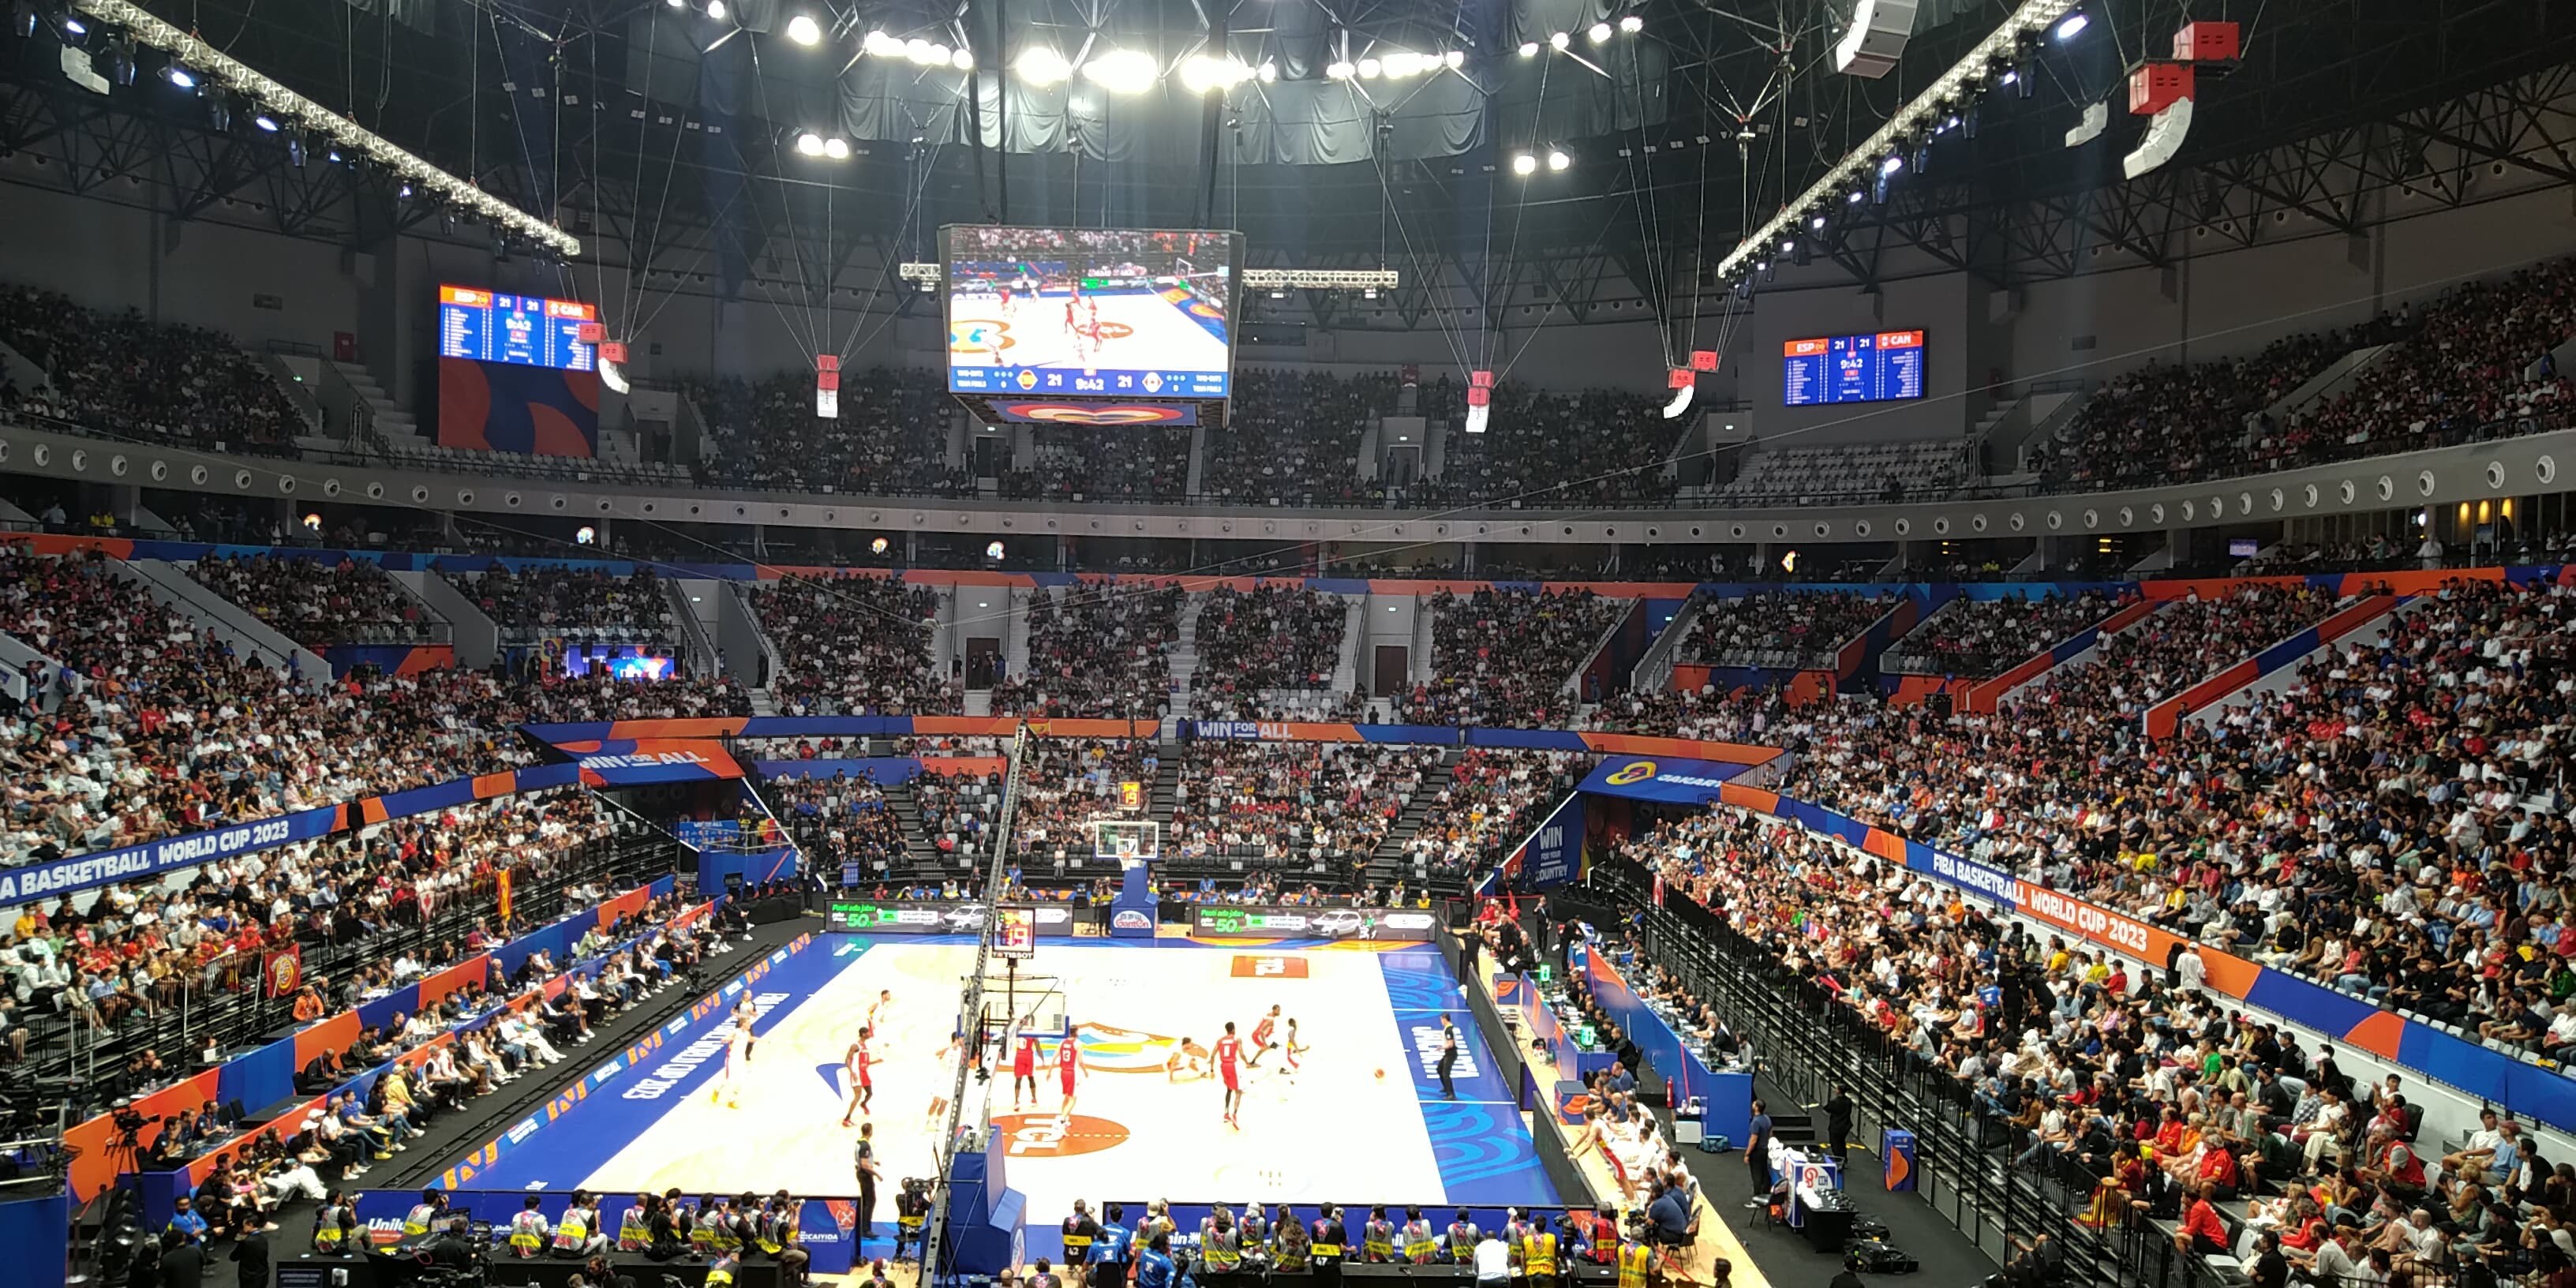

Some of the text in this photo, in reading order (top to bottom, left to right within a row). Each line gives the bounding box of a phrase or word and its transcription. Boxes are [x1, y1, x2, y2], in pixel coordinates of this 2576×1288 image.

[499, 298, 511, 308] 21
[526, 301, 539, 311] 21
[1796, 335, 1911, 353] ESP 21 21 CAN
[1840, 358, 1863, 369] 9:42
[1046, 373, 1062, 387] 21
[1075, 378, 1104, 391] 9:42
[1118, 375, 1133, 388] 21
[1198, 721, 1293, 738] WIN FOR ALL
[579, 751, 710, 769] WIN FOR ALL
[1540, 826, 1563, 850] WIN
[21, 849, 150, 896] BASKETBALL
[159, 834, 216, 863] WORLD
[219, 827, 251, 852] CUP
[253, 821, 289, 845] 2023
[1934, 853, 2147, 952] FIBA BASKETBALL WORLD CUP 2023
[1068, 1246, 1079, 1256] 42
